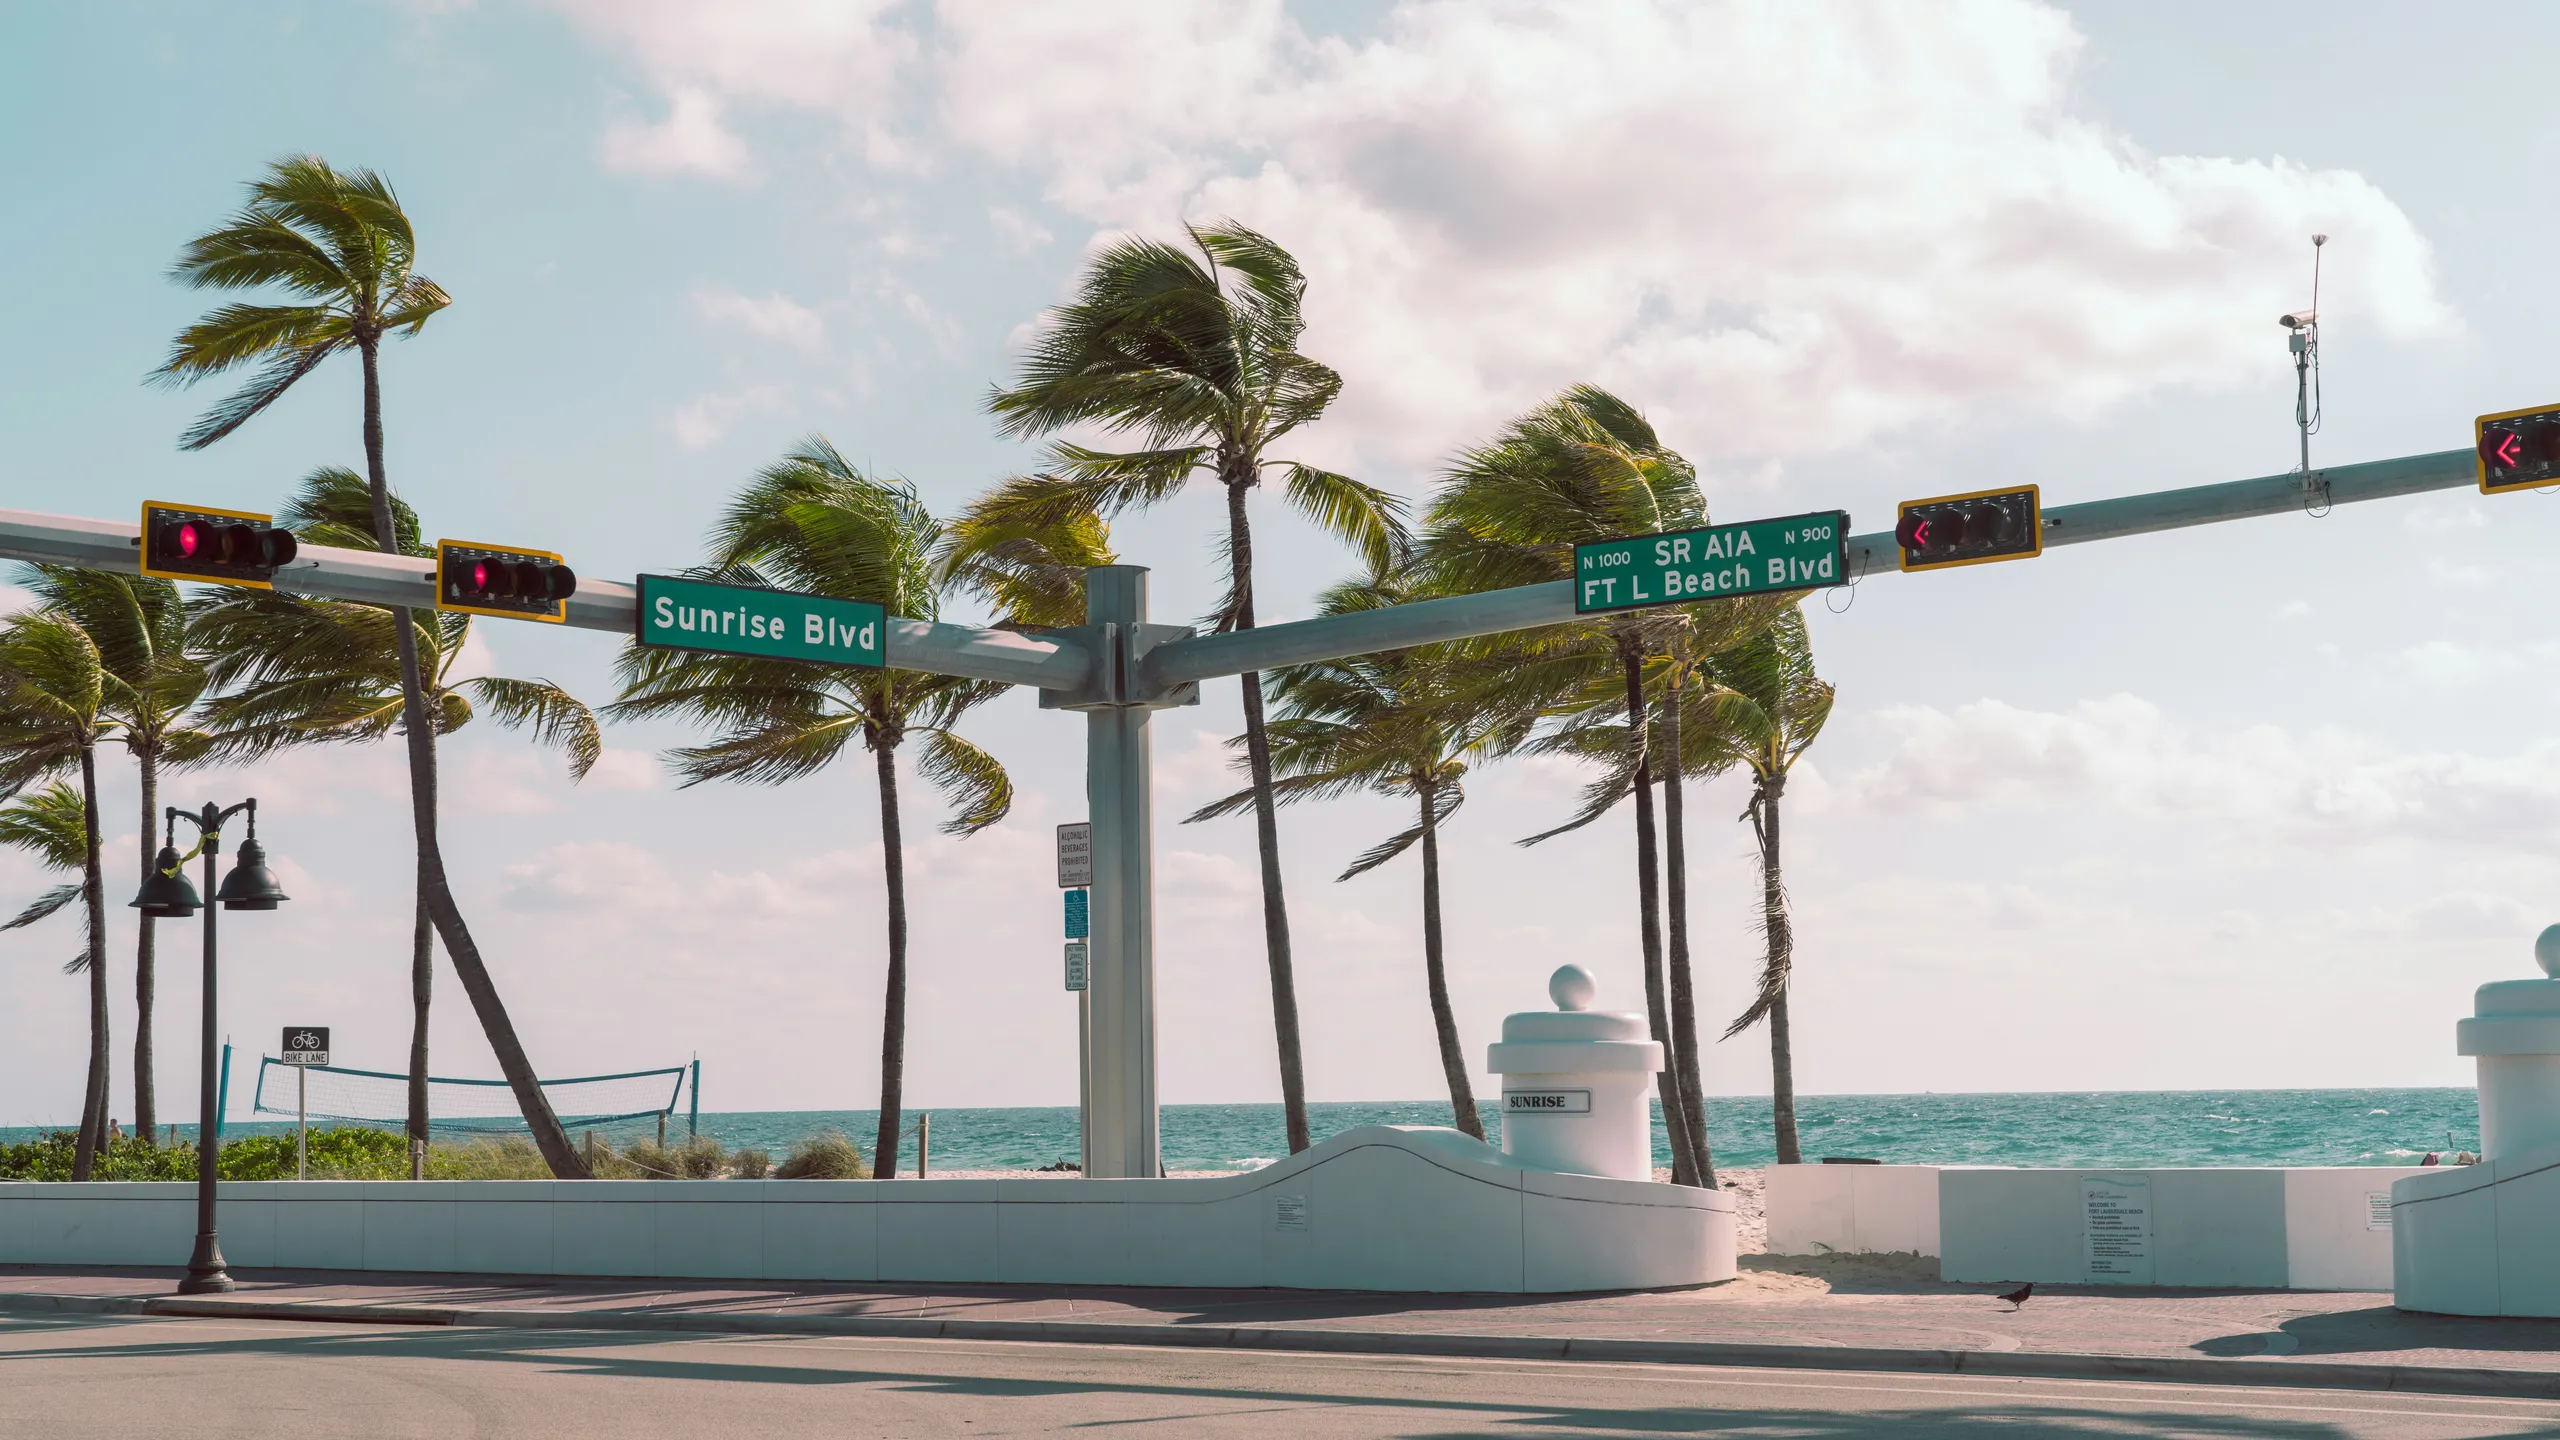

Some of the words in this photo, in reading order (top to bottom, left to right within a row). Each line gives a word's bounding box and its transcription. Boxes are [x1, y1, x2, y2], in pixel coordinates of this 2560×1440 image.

[1785, 531, 1795, 545] N
[1801, 526, 1831, 543] 900
[1654, 538, 1691, 566] SR
[1704, 530, 1756, 561] A1A
[1583, 556, 1593, 569] N
[1599, 551, 1631, 568] 1000
[1584, 578, 1617, 605] FT
[1632, 575, 1649, 600] L
[1664, 563, 1751, 597] Beach
[1767, 551, 1833, 585] Blvd
[654, 596, 785, 640] Sunrise
[804, 613, 875, 651] Blvd
[1061, 830, 1088, 841] ALCOHOLIC
[1061, 843, 1088, 853] BEVERAGES
[1061, 855, 1089, 865] PROHIBITED
[285, 1053, 303, 1063] BIKE
[305, 1053, 326, 1063] LANE
[1510, 1096, 1566, 1108] SUNRISE
